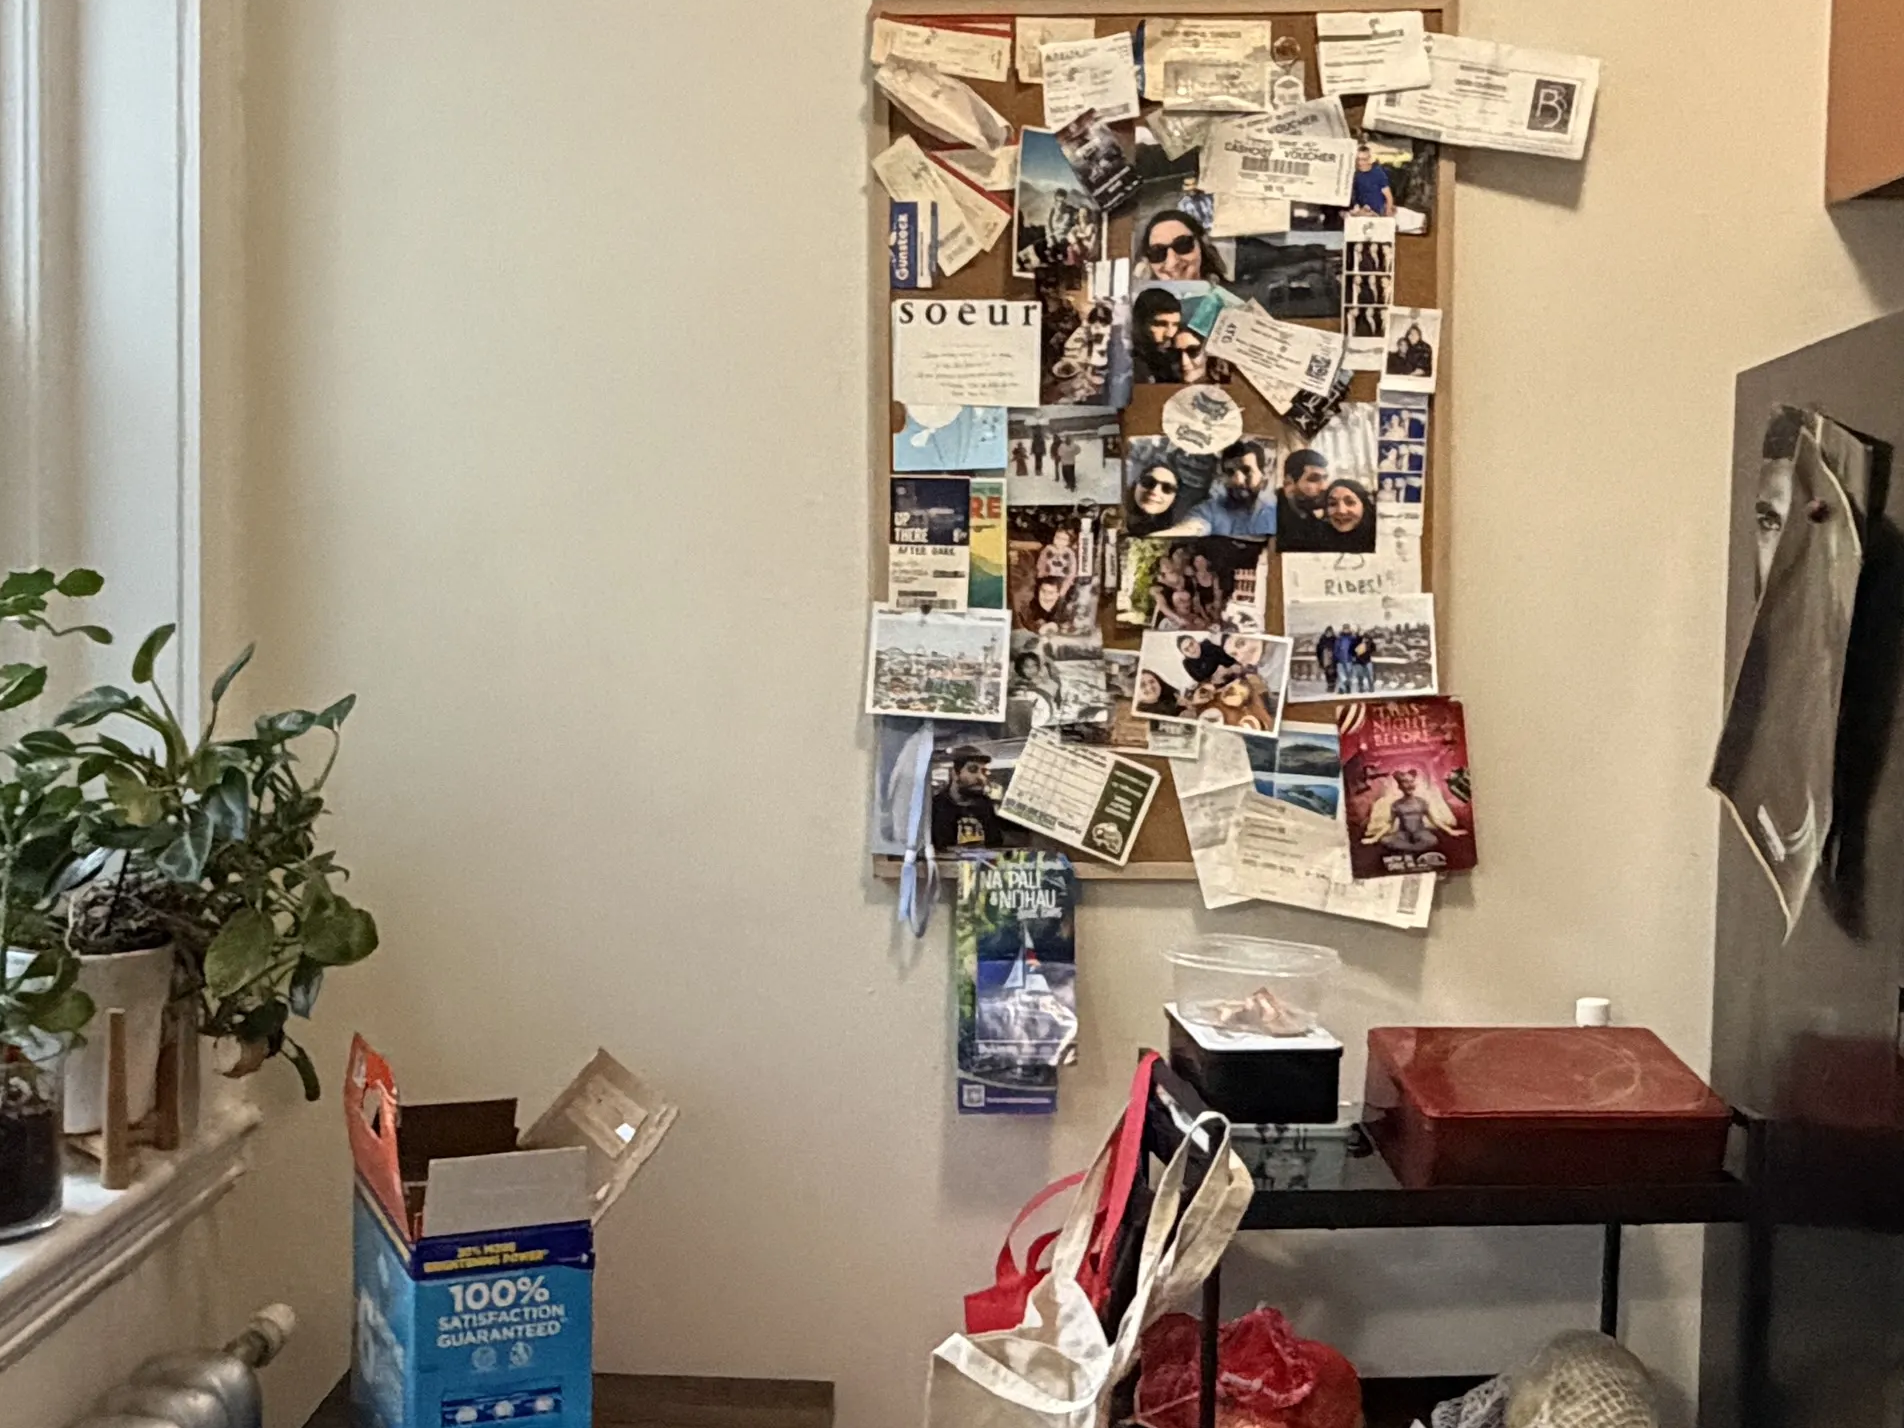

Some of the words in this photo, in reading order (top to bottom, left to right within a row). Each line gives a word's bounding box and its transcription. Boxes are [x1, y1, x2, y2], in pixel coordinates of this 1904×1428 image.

[894, 213, 909, 280] Gunstock
[899, 301, 1038, 326] soeur
[1008, 870, 1042, 889] PALI
[449, 1275, 550, 1312] 100%
[437, 1303, 566, 1332] SATISFACTION
[436, 1319, 562, 1349] GUARANTEED
